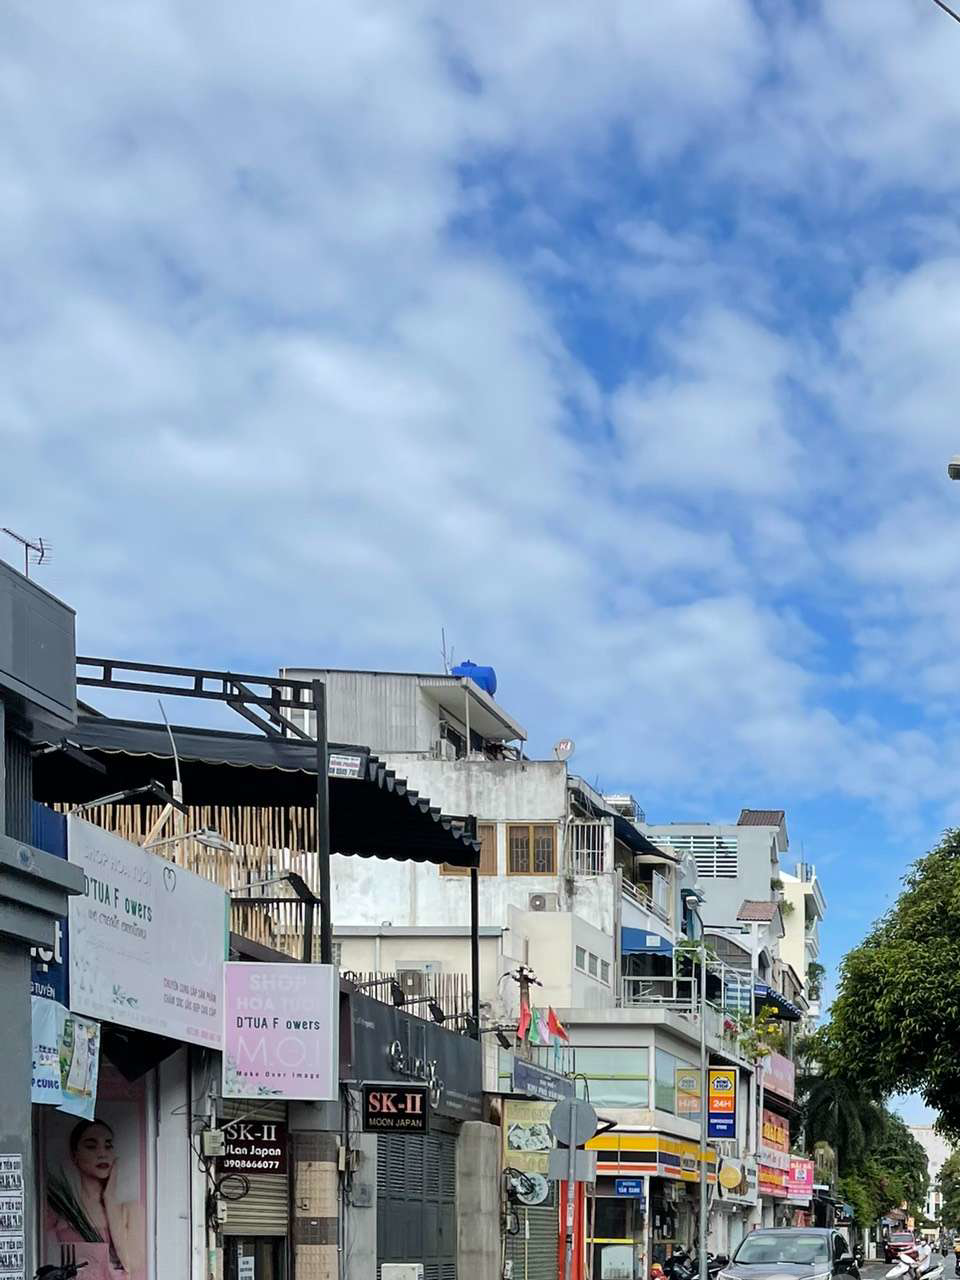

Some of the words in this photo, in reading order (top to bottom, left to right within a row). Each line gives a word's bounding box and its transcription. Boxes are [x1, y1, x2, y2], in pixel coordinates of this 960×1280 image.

[236, 1016, 268, 1030] D'TUA
[369, 1092, 423, 1114] SK-II
[712, 1100, 732, 1108] 24H
[369, 1118, 394, 1127] MOON
[396, 1118, 422, 1128] JAPAN
[226, 1123, 277, 1142] SK-II
[250, 1145, 281, 1158] Japan
